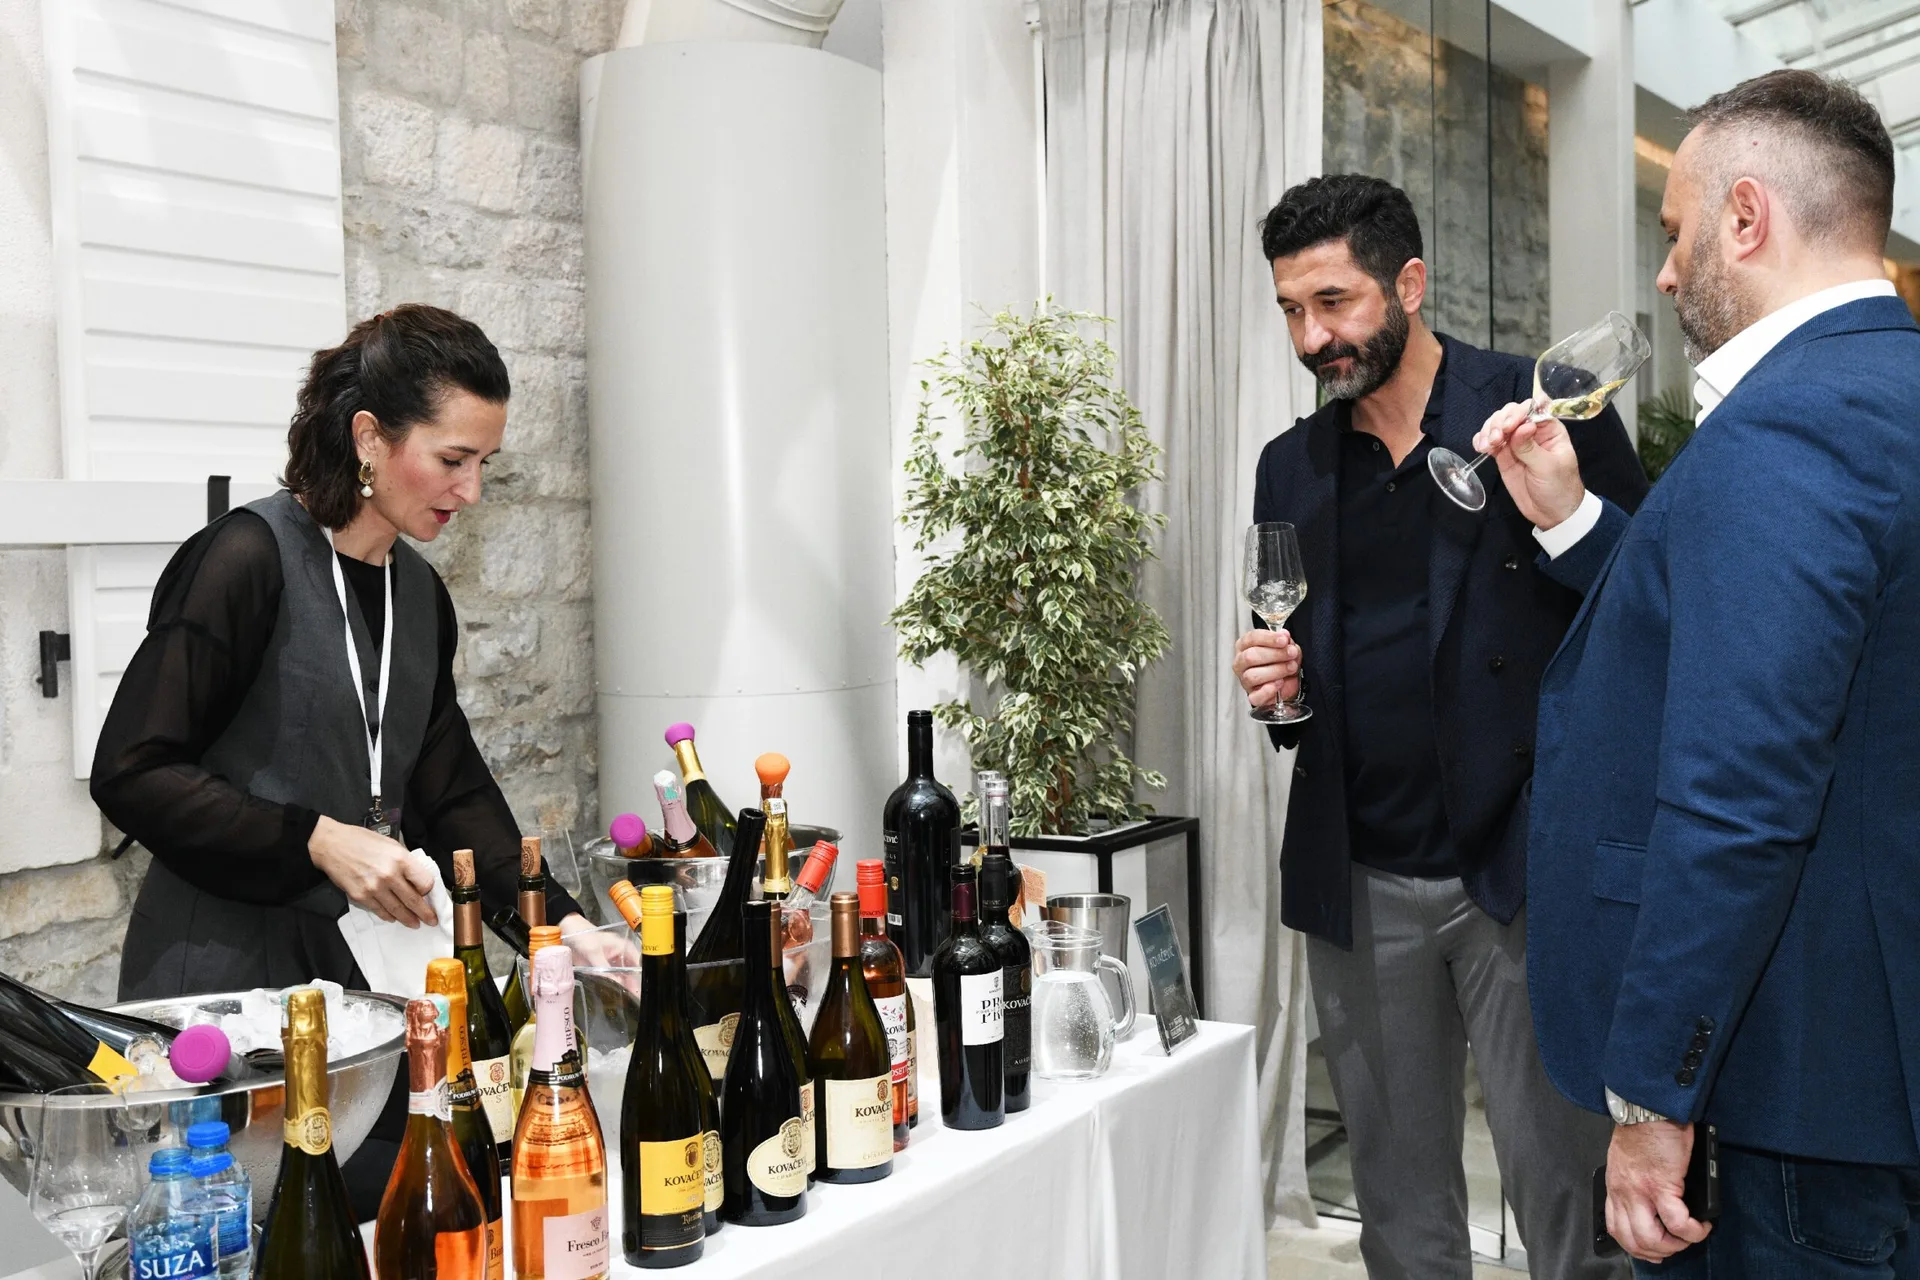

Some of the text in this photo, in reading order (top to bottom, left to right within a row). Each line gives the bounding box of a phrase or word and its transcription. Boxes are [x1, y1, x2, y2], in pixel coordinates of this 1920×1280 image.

[563, 1006, 573, 1047] FRESCO
[459, 1025, 469, 1066] FRESCO
[567, 1236, 600, 1252] Fresco
[140, 1250, 205, 1279] SUZA
